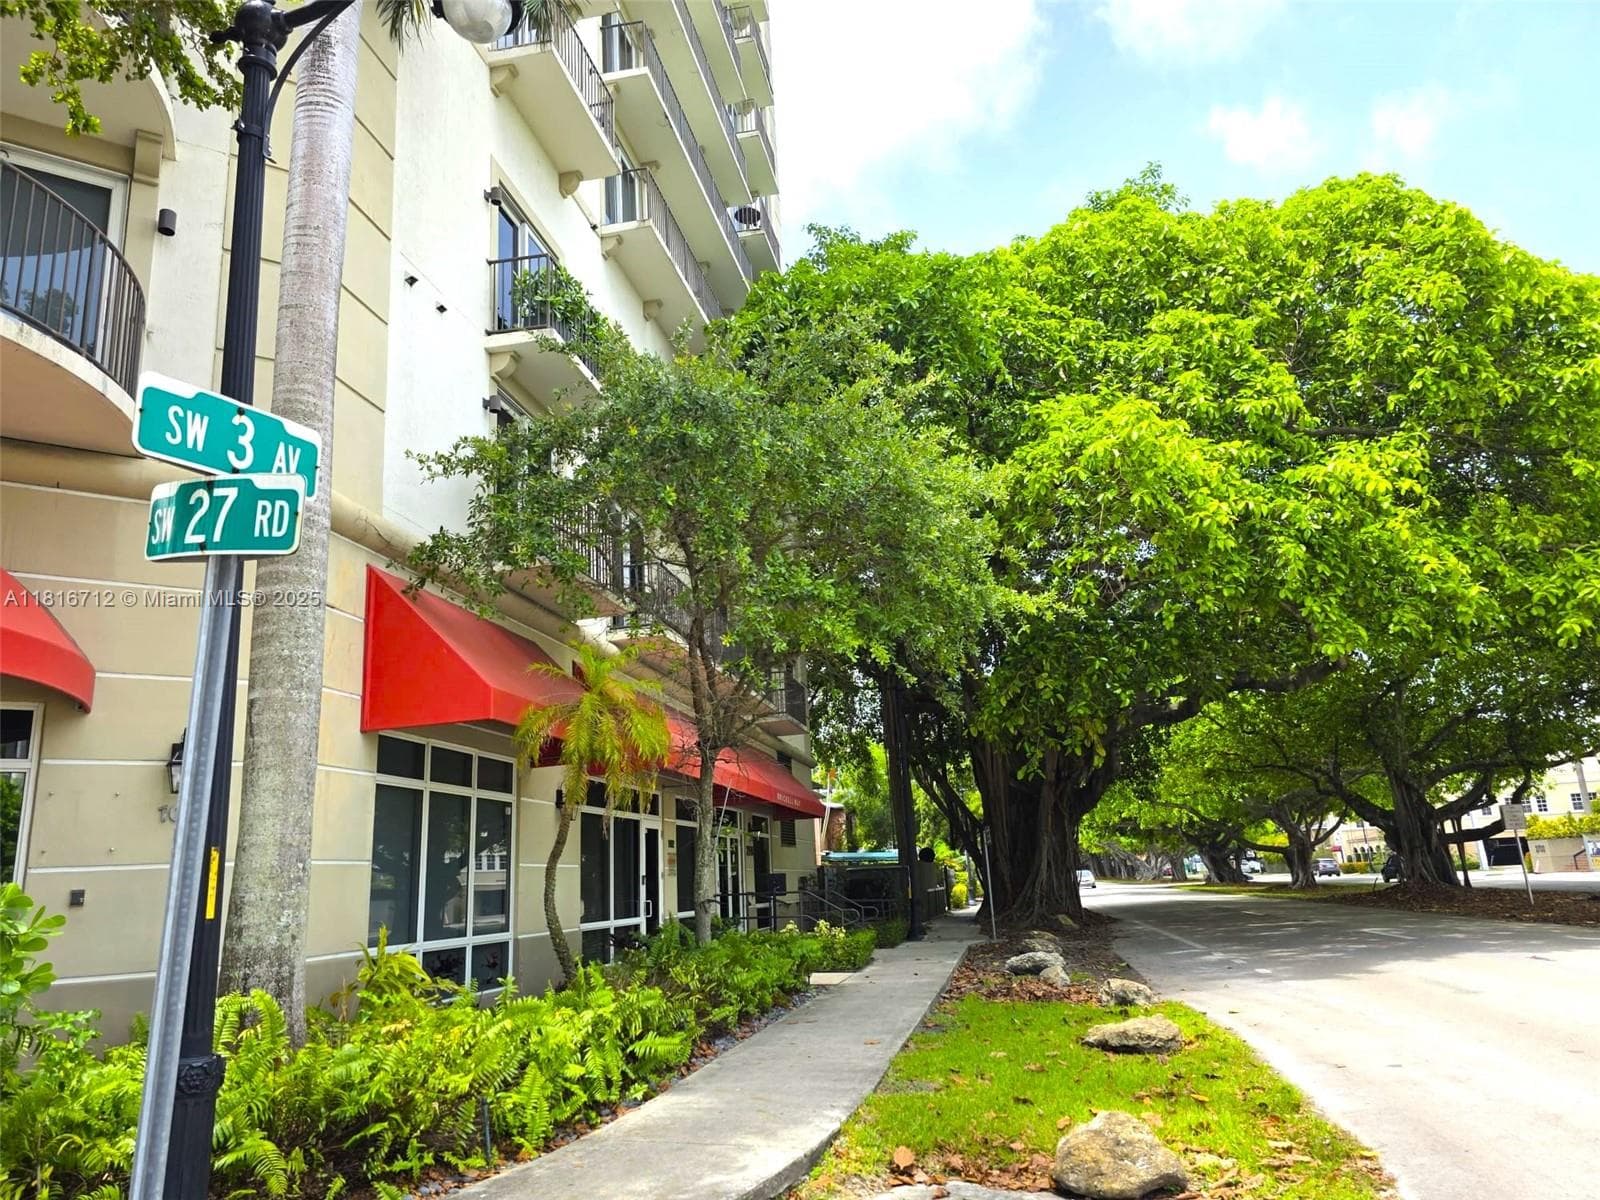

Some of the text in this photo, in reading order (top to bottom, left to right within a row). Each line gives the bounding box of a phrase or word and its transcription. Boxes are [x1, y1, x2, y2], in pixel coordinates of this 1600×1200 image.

[165, 405, 301, 474] SW 3 AV
[151, 487, 290, 545] SW 27 RD
